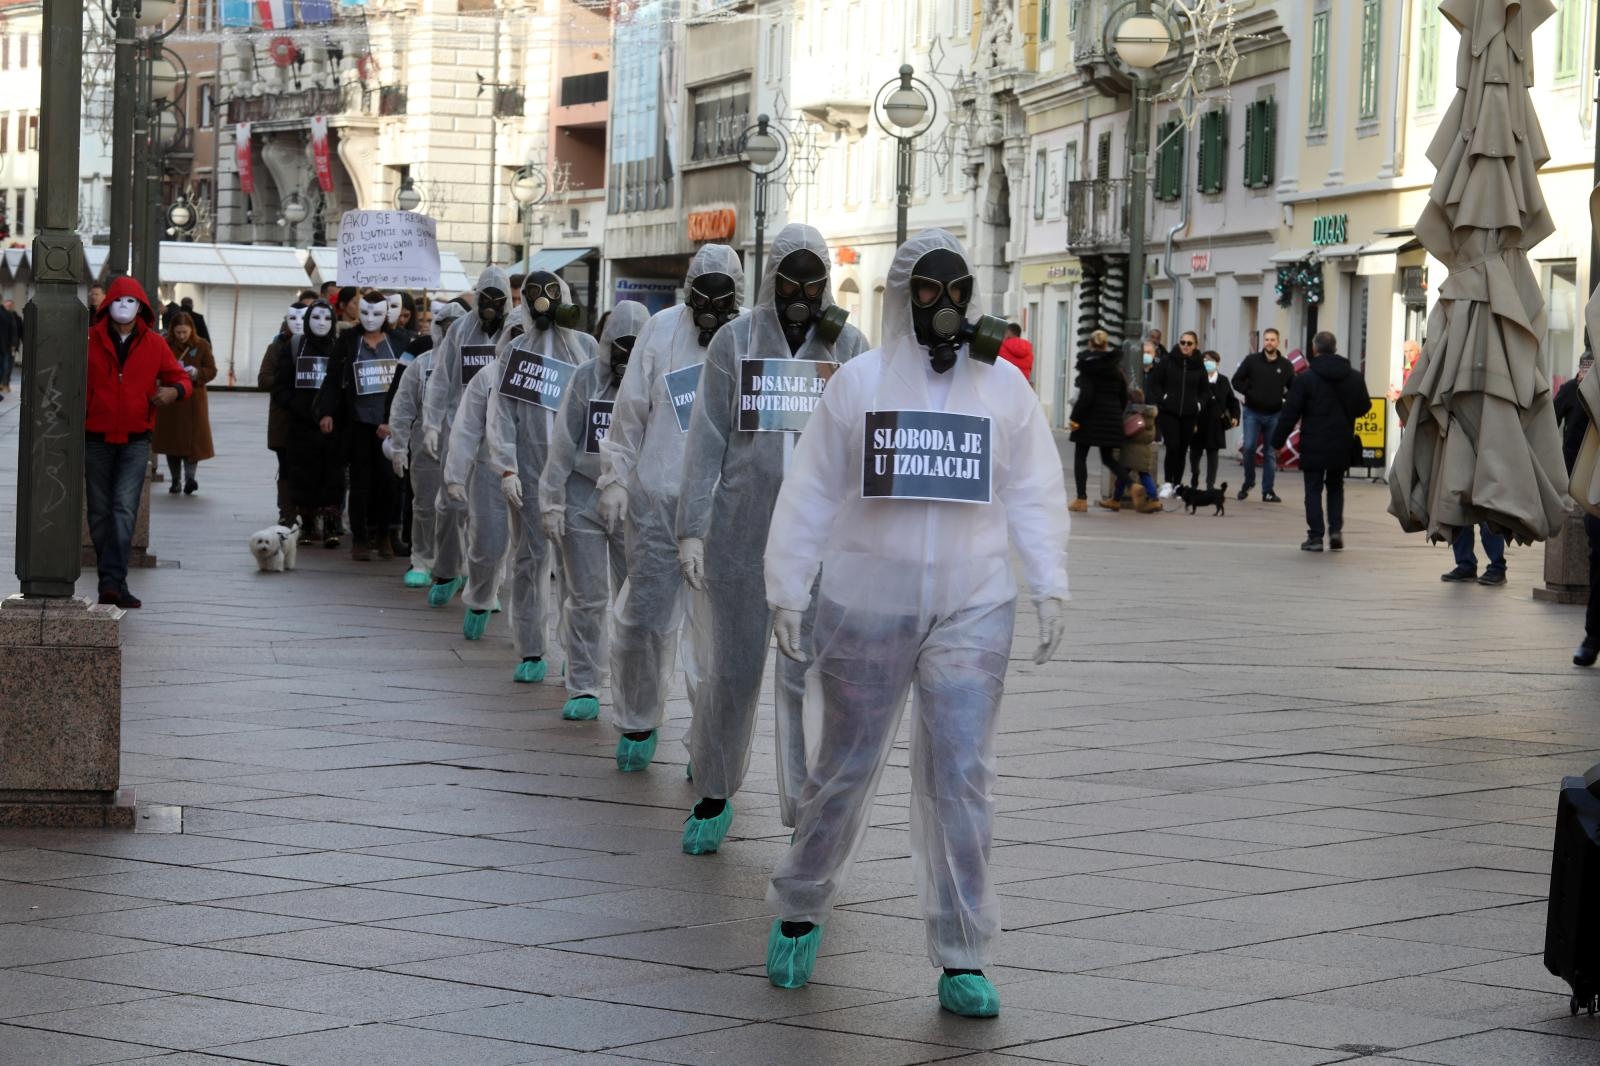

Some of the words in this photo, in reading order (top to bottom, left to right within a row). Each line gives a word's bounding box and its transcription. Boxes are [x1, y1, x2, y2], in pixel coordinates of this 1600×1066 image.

[343, 213, 369, 230] AKO
[376, 212, 391, 225] SE
[1312, 214, 1348, 245] DOUGLAS
[342, 232, 355, 244] OD
[518, 360, 558, 383] CJEPIVO
[509, 372, 524, 387] JE
[523, 376, 561, 398] ZDRAVO
[752, 375, 807, 393] DISANJE
[810, 377, 826, 393] JE
[873, 428, 956, 452] SLOBODA
[960, 432, 982, 454] JE
[874, 454, 888, 476] U
[892, 454, 981, 480] IZOLACIJI
